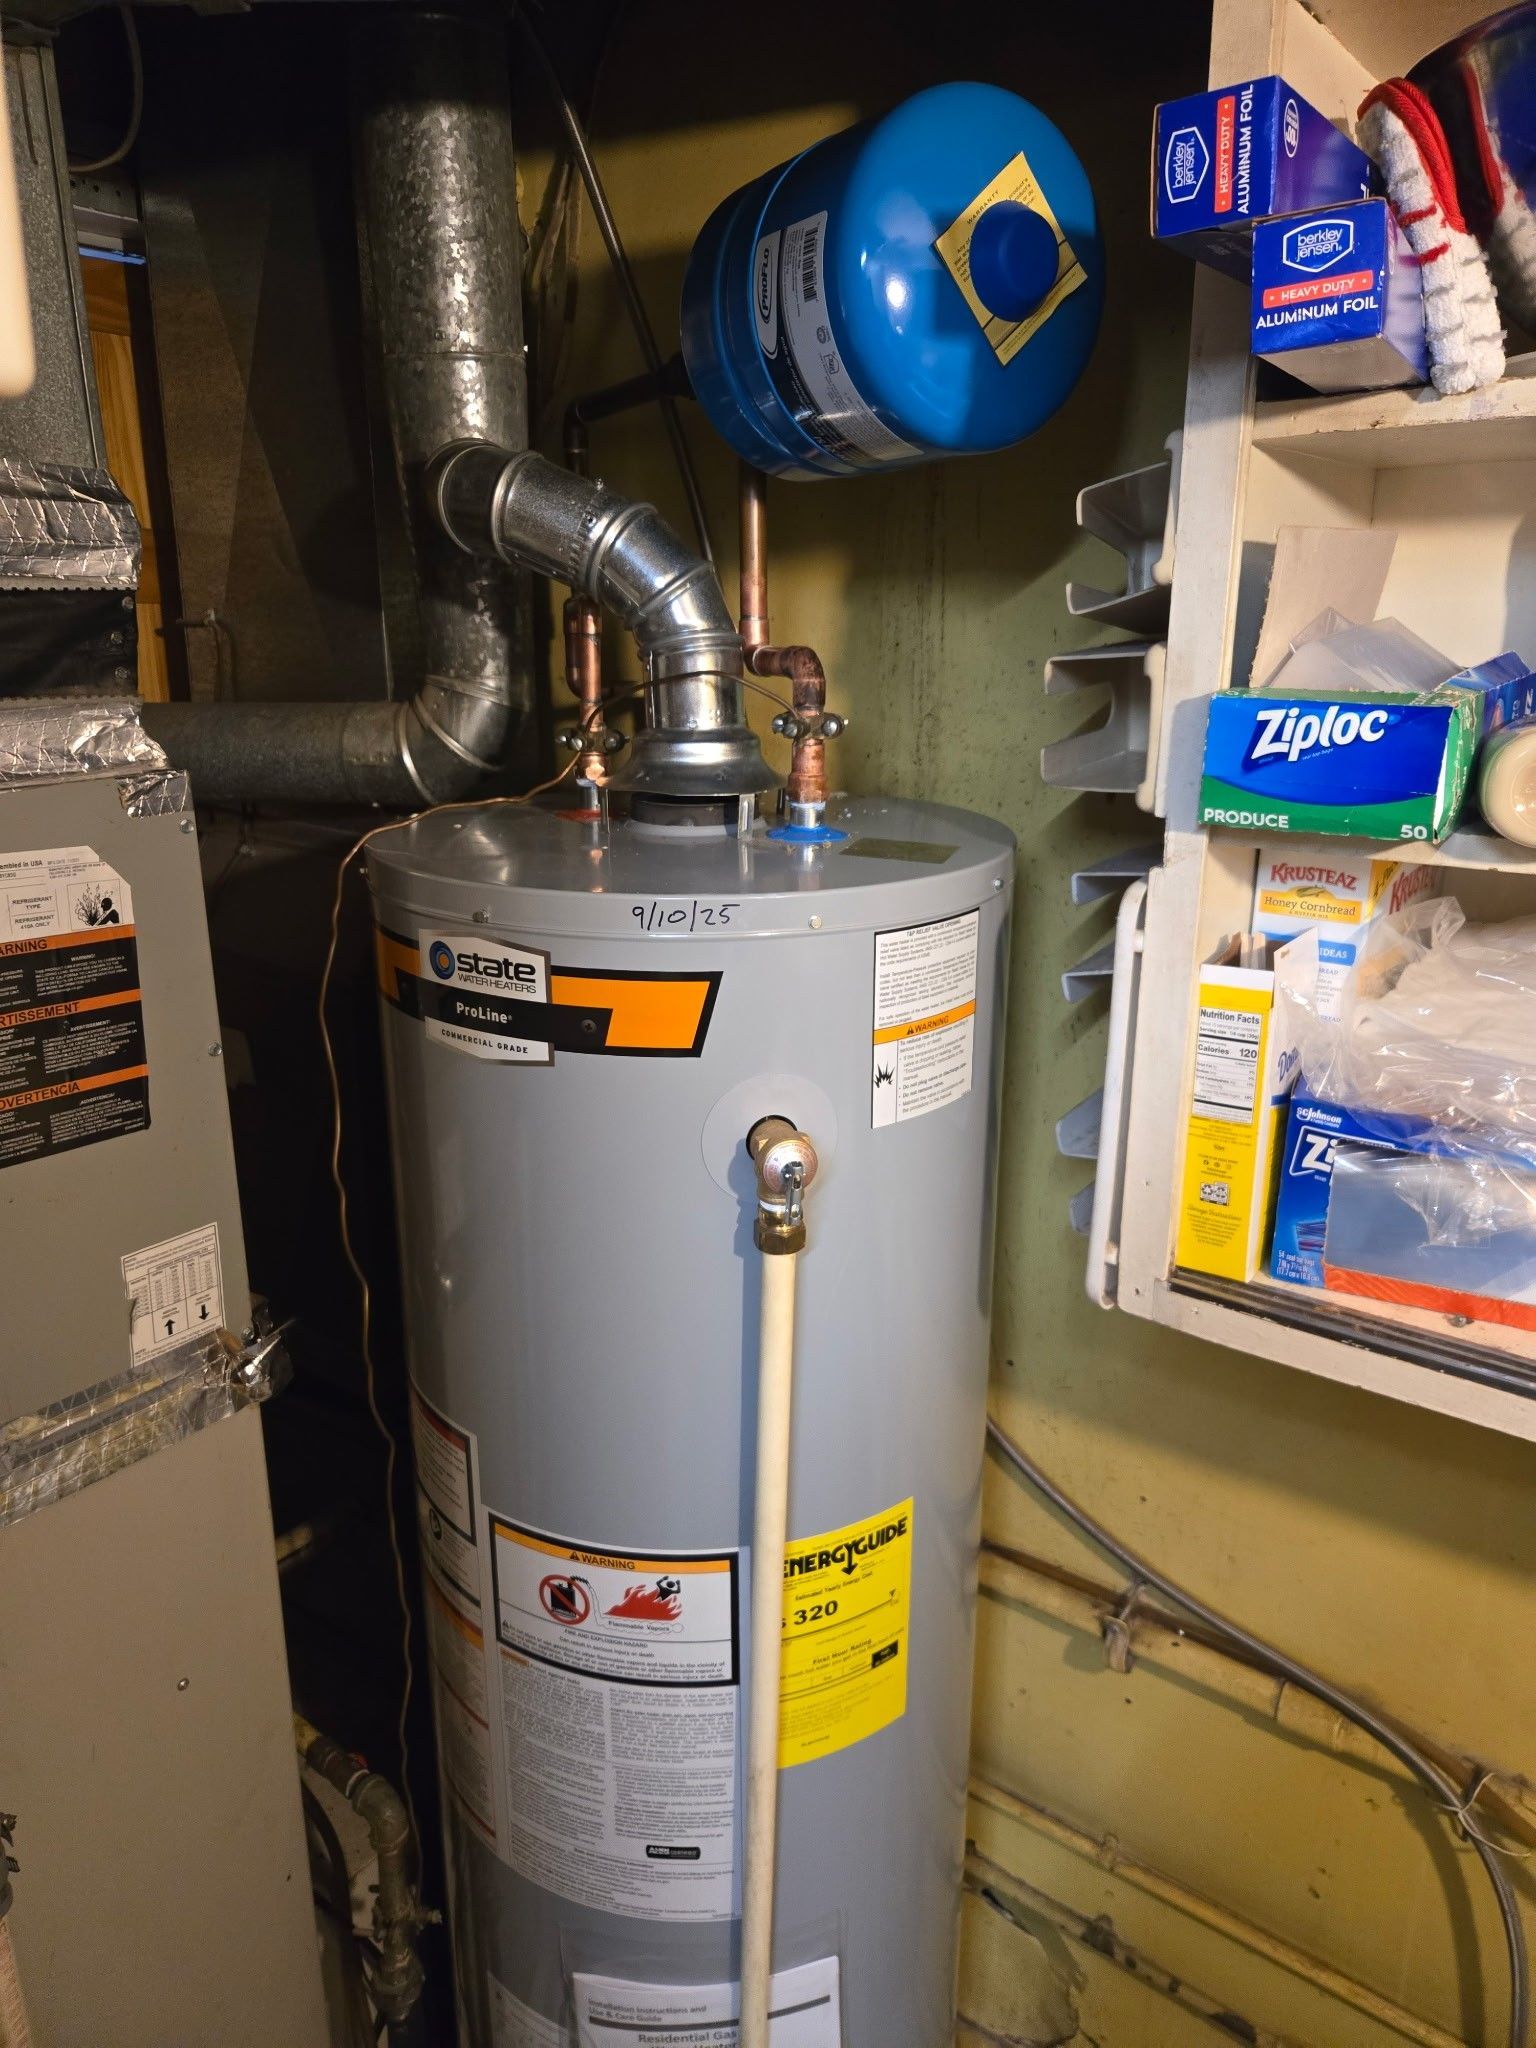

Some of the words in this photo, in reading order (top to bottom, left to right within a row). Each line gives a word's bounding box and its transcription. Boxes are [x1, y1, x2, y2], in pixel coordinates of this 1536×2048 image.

[1240, 84, 1254, 122] FOIL
[1220, 117, 1231, 150] DUTY
[1172, 142, 1186, 188] berkley
[1219, 155, 1229, 194] HEAVY
[1237, 126, 1252, 214] ALUMINUM
[966, 189, 999, 225] WARRANTY
[1297, 228, 1343, 247] berkley
[1281, 285, 1320, 301] HEAVY
[1322, 279, 1355, 293] DUTY
[1255, 302, 1338, 330] ALUMINUM
[1343, 296, 1378, 314] FOIL
[1250, 706, 1389, 762] Ziploc
[1203, 808, 1289, 829] PRODUCE
[1399, 824, 1428, 840] 50
[1270, 862, 1359, 891] KRUSTEAZ
[12, 896, 53, 905] REFRIGERANT
[1264, 896, 1297, 909] Honey
[1299, 900, 1356, 917] Cornbread
[15, 914, 55, 924] REFRIGERANT
[631, 900, 741, 932] 9/10/25
[1319, 946, 1348, 959] IDEAS
[456, 953, 536, 984] state
[457, 972, 489, 987] WATER
[489, 981, 537, 994] HEATERS
[914, 1015, 949, 1033] WARNING
[1200, 1008, 1235, 1022] Nutrition
[1236, 1014, 1260, 1025] Facts
[441, 1028, 493, 1048] COMMERCIAL
[497, 1042, 528, 1054] GRADE
[1198, 1044, 1230, 1056] Calories
[1239, 1048, 1258, 1059] 120
[581, 1553, 636, 1570] WARNING
[793, 1600, 839, 1626] 320
[608, 1620, 644, 1630] Flammable
[646, 1624, 670, 1632] Vapors
[577, 1631, 589, 1639] AND
[623, 1640, 648, 1648] HAZARD
[614, 2012, 635, 2021] Care
[636, 2014, 662, 2022] Guide
[636, 2005, 688, 2014] Instructions
[689, 2004, 707, 2013] and
[638, 2032, 710, 2043] Residential
[713, 2031, 737, 2041] Gas
